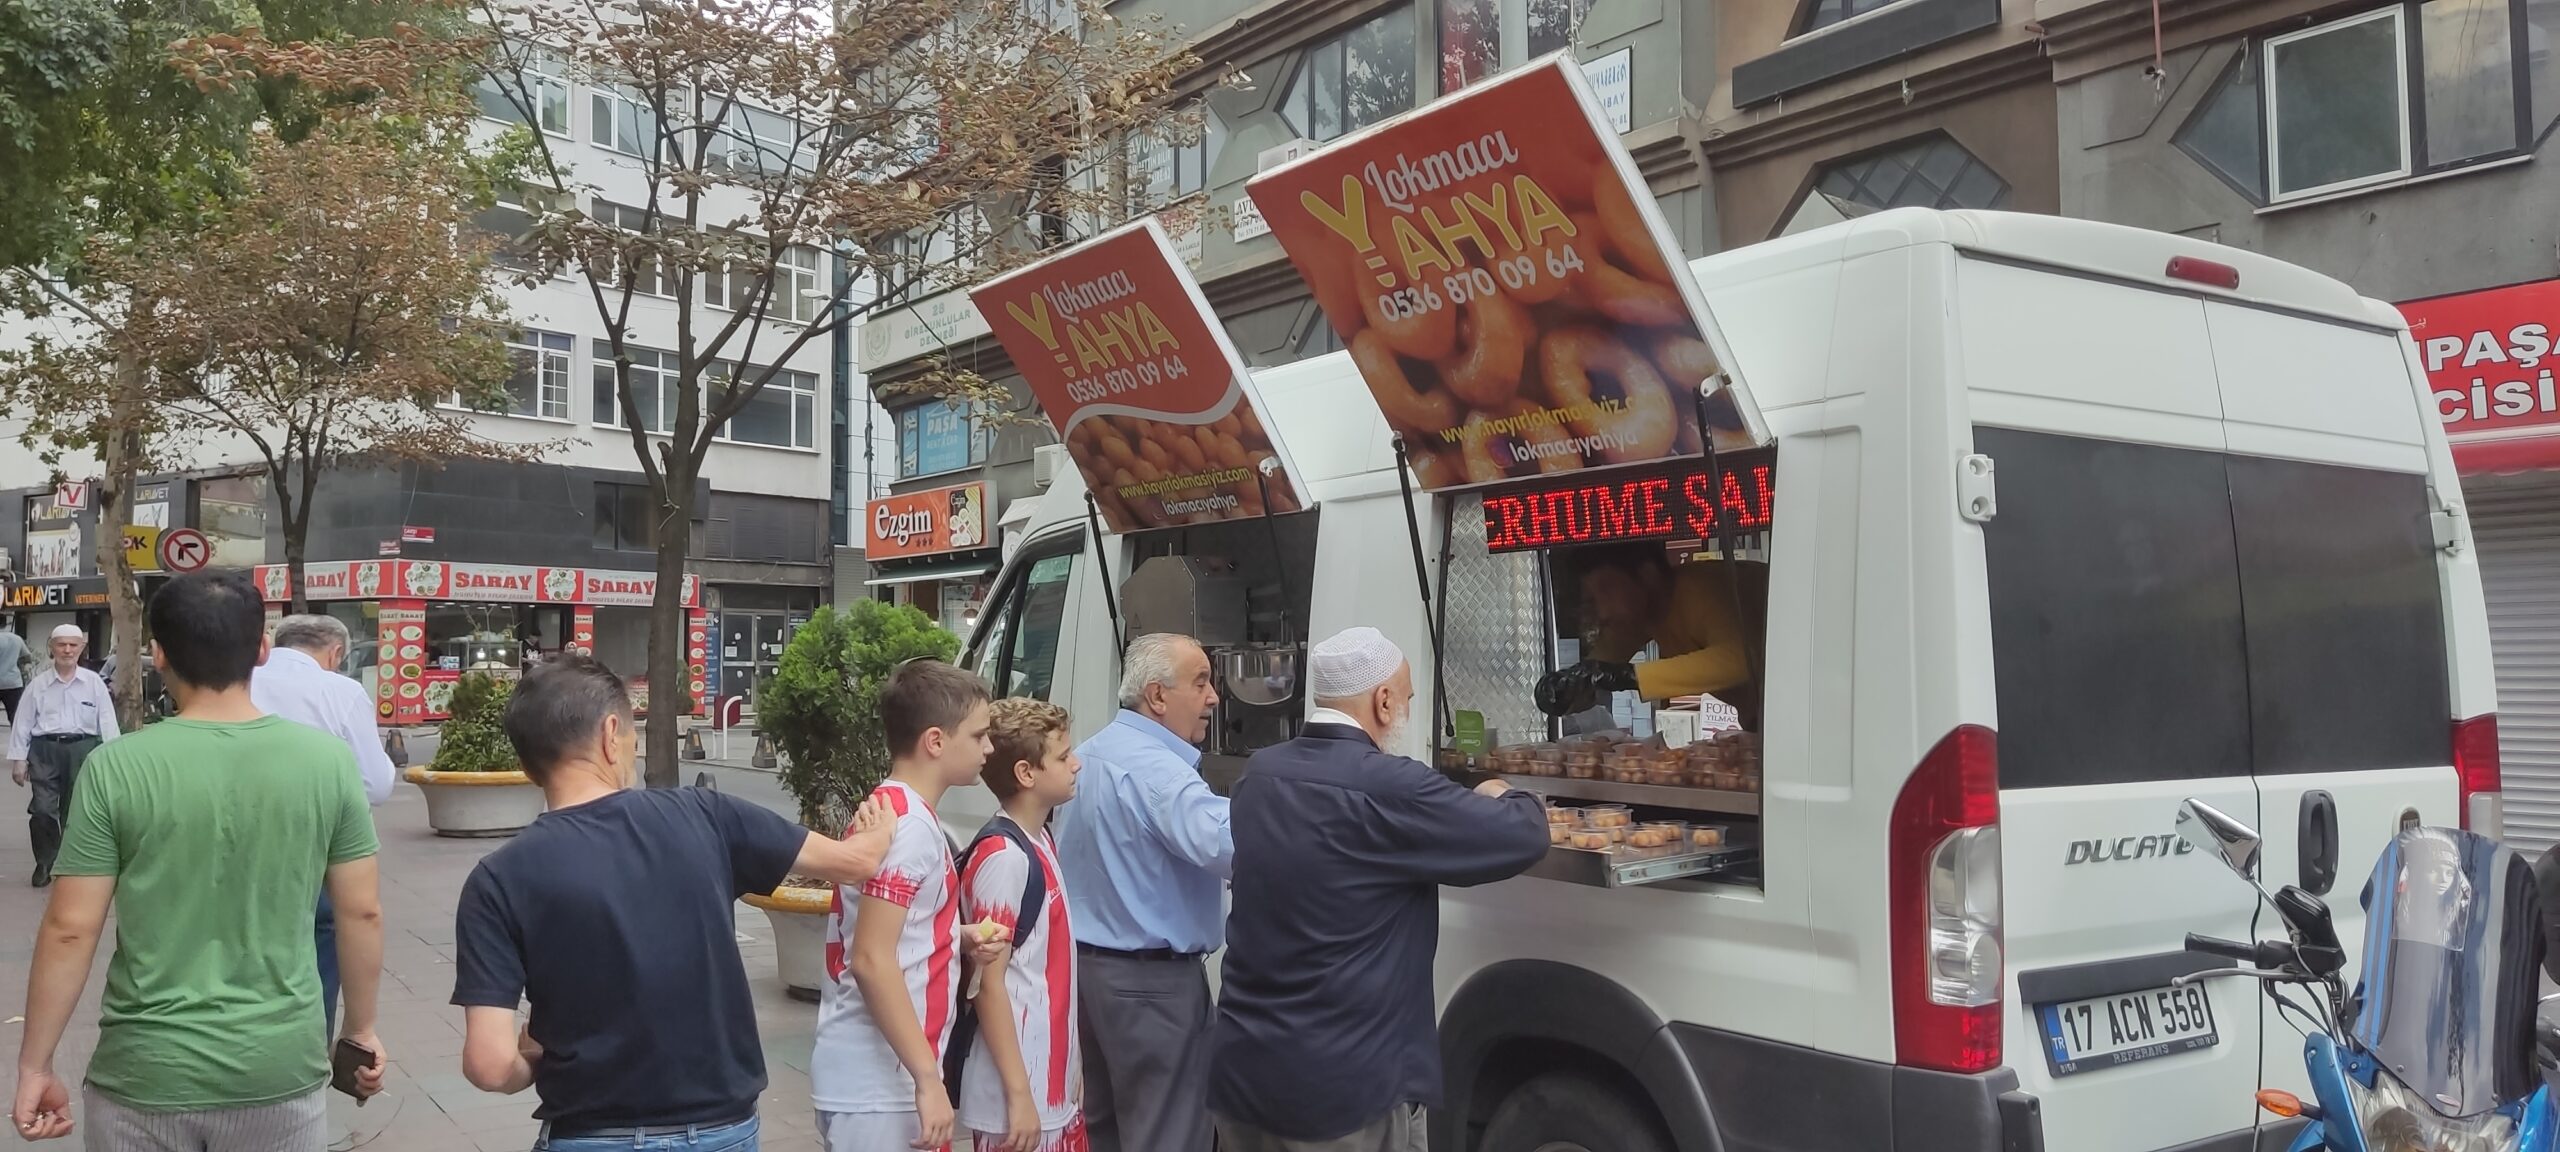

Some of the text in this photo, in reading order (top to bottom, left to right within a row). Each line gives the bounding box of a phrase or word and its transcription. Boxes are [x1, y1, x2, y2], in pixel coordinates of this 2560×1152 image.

[1364, 130, 1519, 213] Lokmacı
[1378, 244, 1585, 321] 0536 870 09 64
[1043, 269, 1137, 324] Lokmacı
[2414, 322, 2560, 372] PAŞ
[1066, 355, 1188, 403] 0536 870 09 64
[927, 413, 958, 436] PAŞA
[875, 504, 932, 546] ezgim
[306, 571, 347, 588] ARAY
[455, 571, 532, 591] SARAY
[587, 577, 656, 596] SARAY
[4, 584, 68, 607] LARIAVET
[1706, 714, 1737, 723] YILMAZ
[2064, 988, 2205, 1052] 17 ACN 558
[2052, 1037, 2065, 1050] TR
[2113, 1044, 2169, 1064] REFERANS
